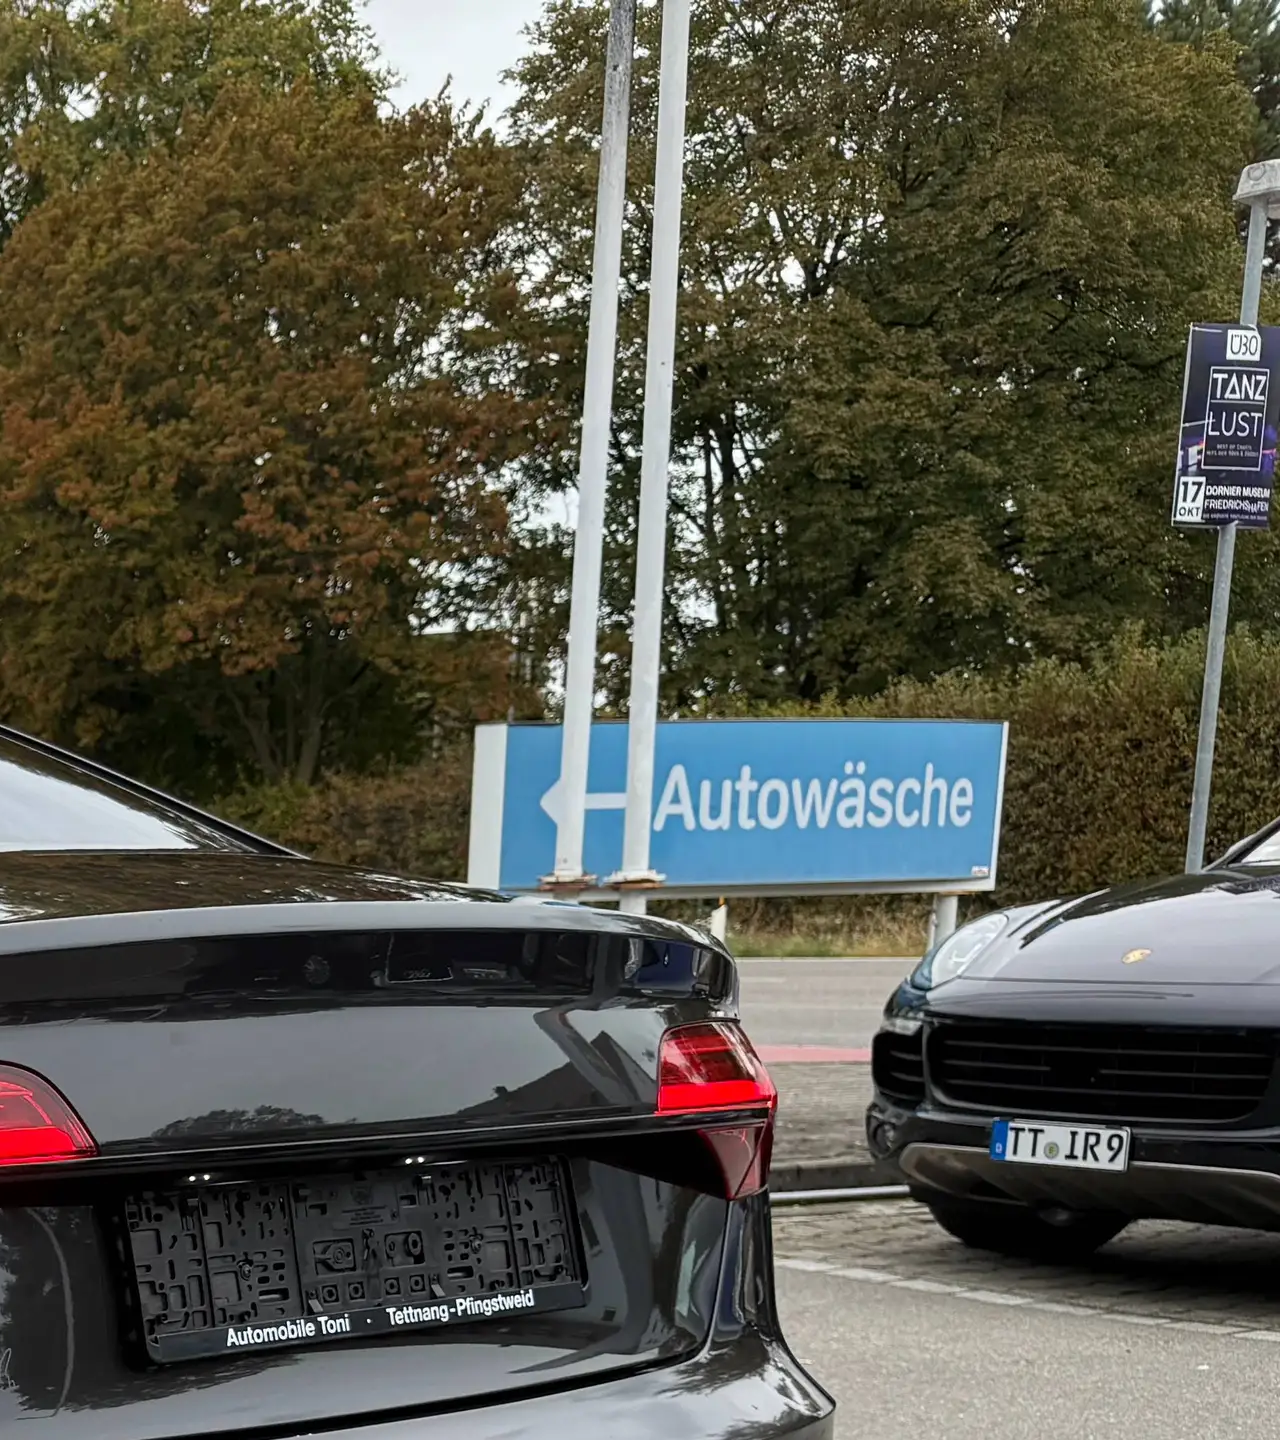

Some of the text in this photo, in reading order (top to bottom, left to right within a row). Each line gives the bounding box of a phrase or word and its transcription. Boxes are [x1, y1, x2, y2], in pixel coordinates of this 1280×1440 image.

[1230, 333, 1259, 355] Ü30
[1213, 372, 1267, 400] TANZ
[1208, 411, 1263, 437] LUST
[1182, 481, 1203, 503] 17
[1206, 485, 1270, 498] DORNIER MUSEUM
[1179, 507, 1201, 516] OKT
[1204, 498, 1269, 513] FRIEDRICHSHAFEN
[652, 760, 974, 832] Autowäsche
[1009, 1127, 1044, 1157] TT
[226, 1289, 535, 1347] Automobile Toni Tettnang-Pfingstweid
